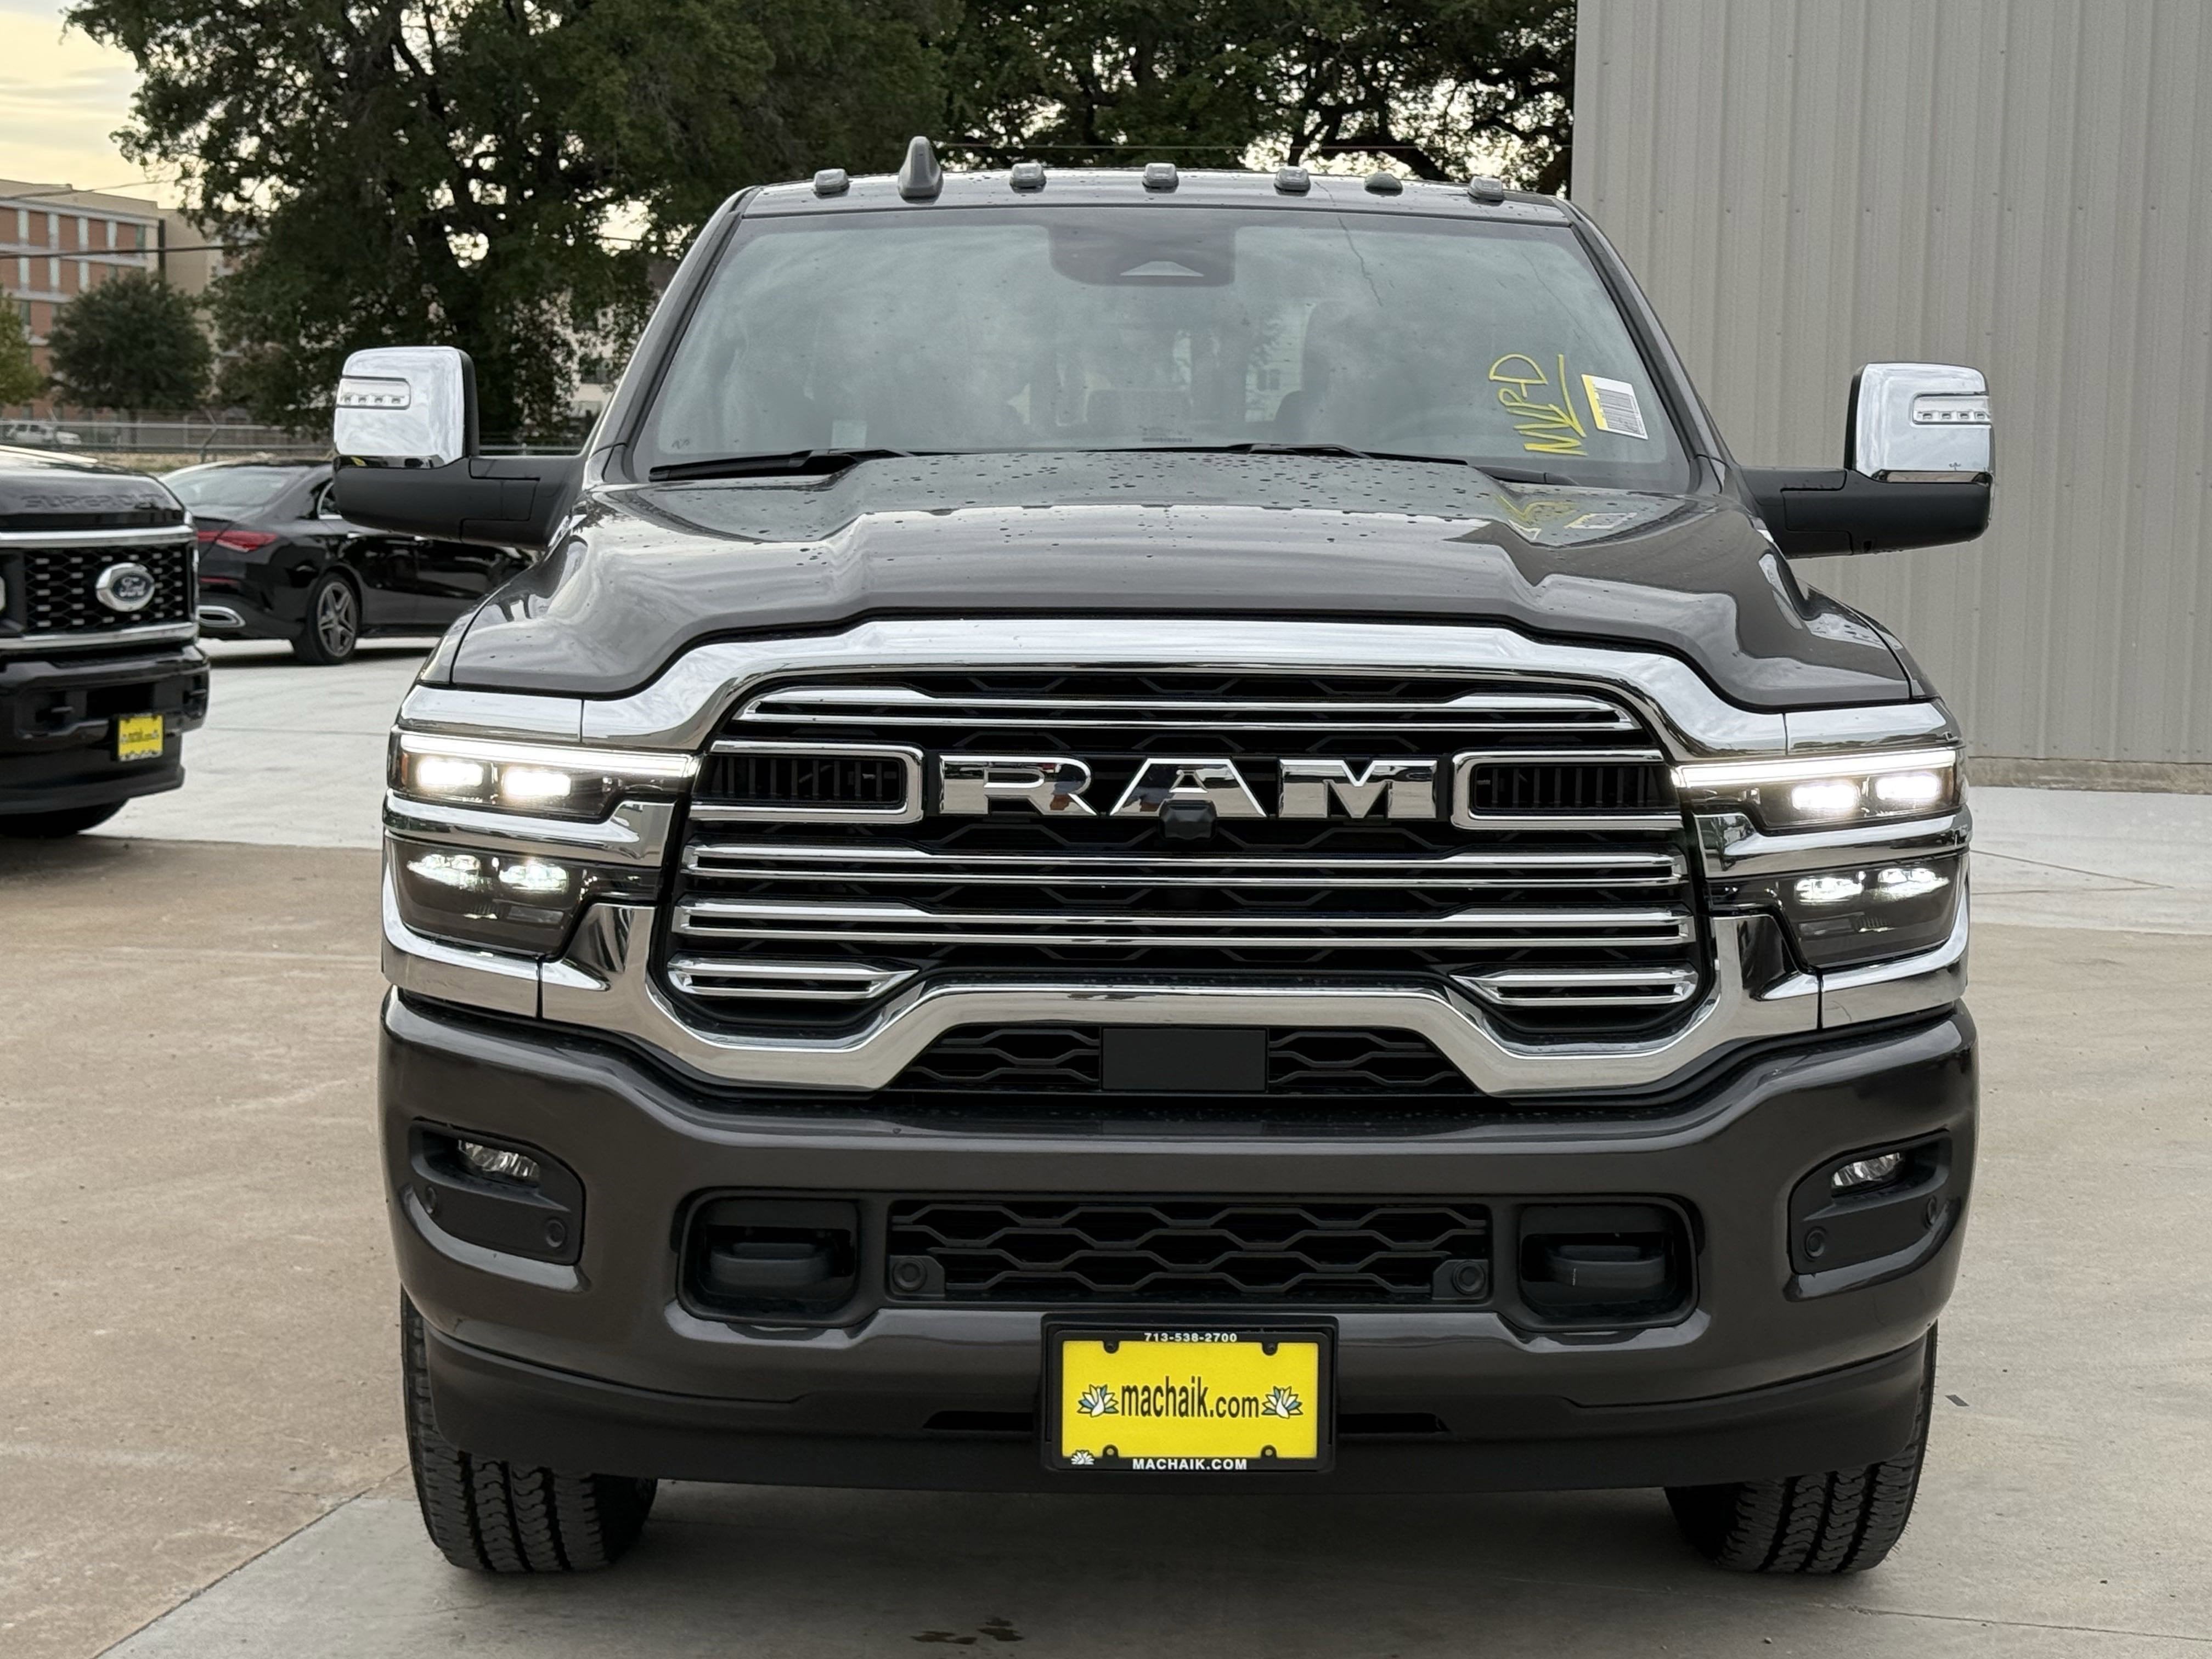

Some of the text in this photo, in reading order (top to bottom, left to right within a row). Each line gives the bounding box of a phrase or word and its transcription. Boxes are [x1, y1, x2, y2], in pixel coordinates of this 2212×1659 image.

[939, 754, 1438, 819] RAM
[1144, 1333, 1238, 1342] 713-538-2700
[1121, 1376, 1260, 1418] machaik.com
[1132, 1458, 1248, 1470] MACHAIK.COM
